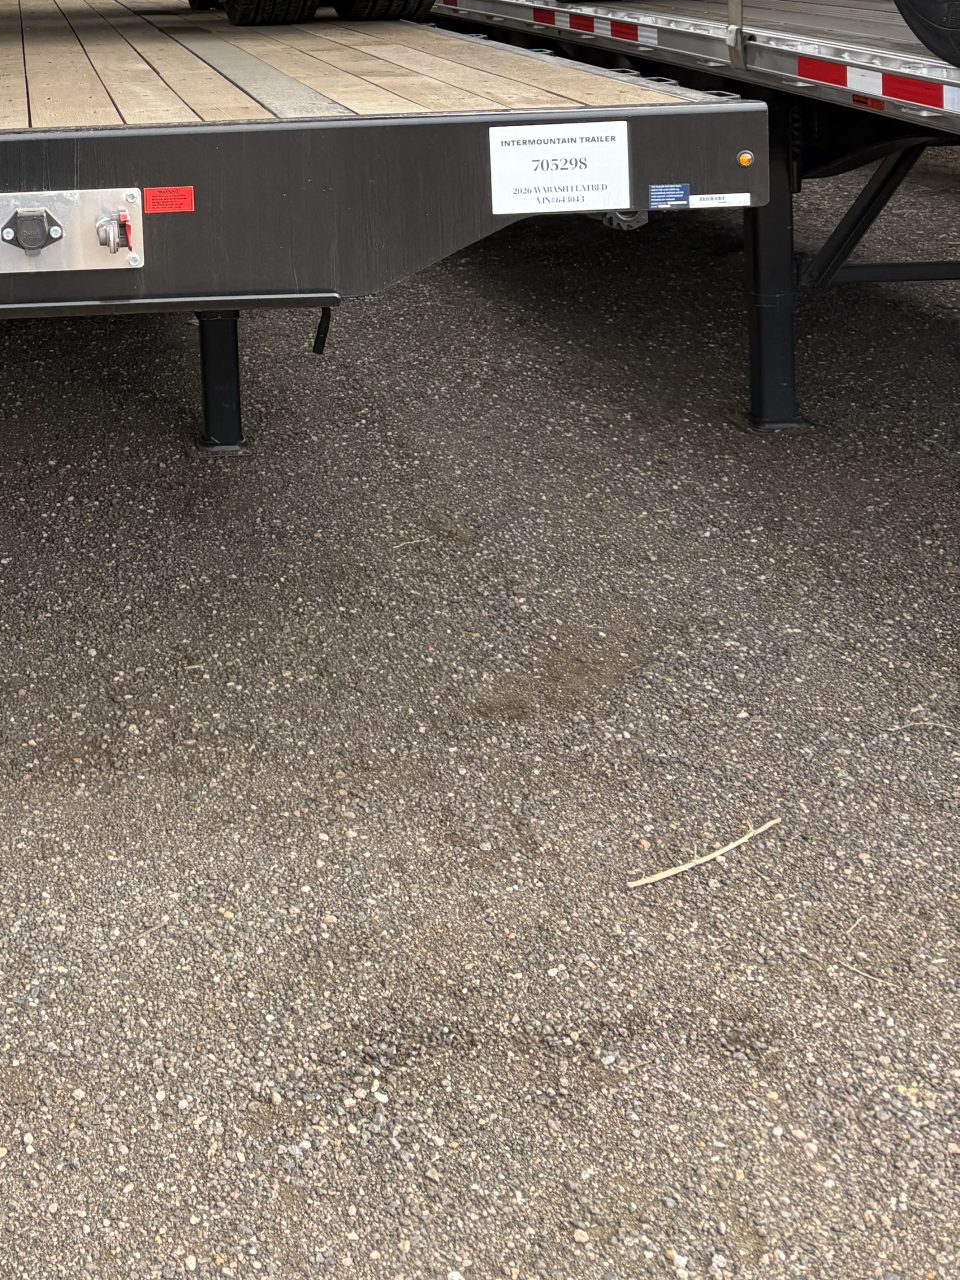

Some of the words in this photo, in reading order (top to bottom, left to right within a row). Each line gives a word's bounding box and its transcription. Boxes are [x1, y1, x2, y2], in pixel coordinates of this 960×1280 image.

[500, 136, 578, 148] INTERMOUNTAIN
[578, 135, 617, 144] TRAILER
[531, 156, 589, 173] 705298
[512, 186, 533, 195] 2026
[533, 184, 570, 195] WABASH
[570, 183, 609, 193] FLATBED
